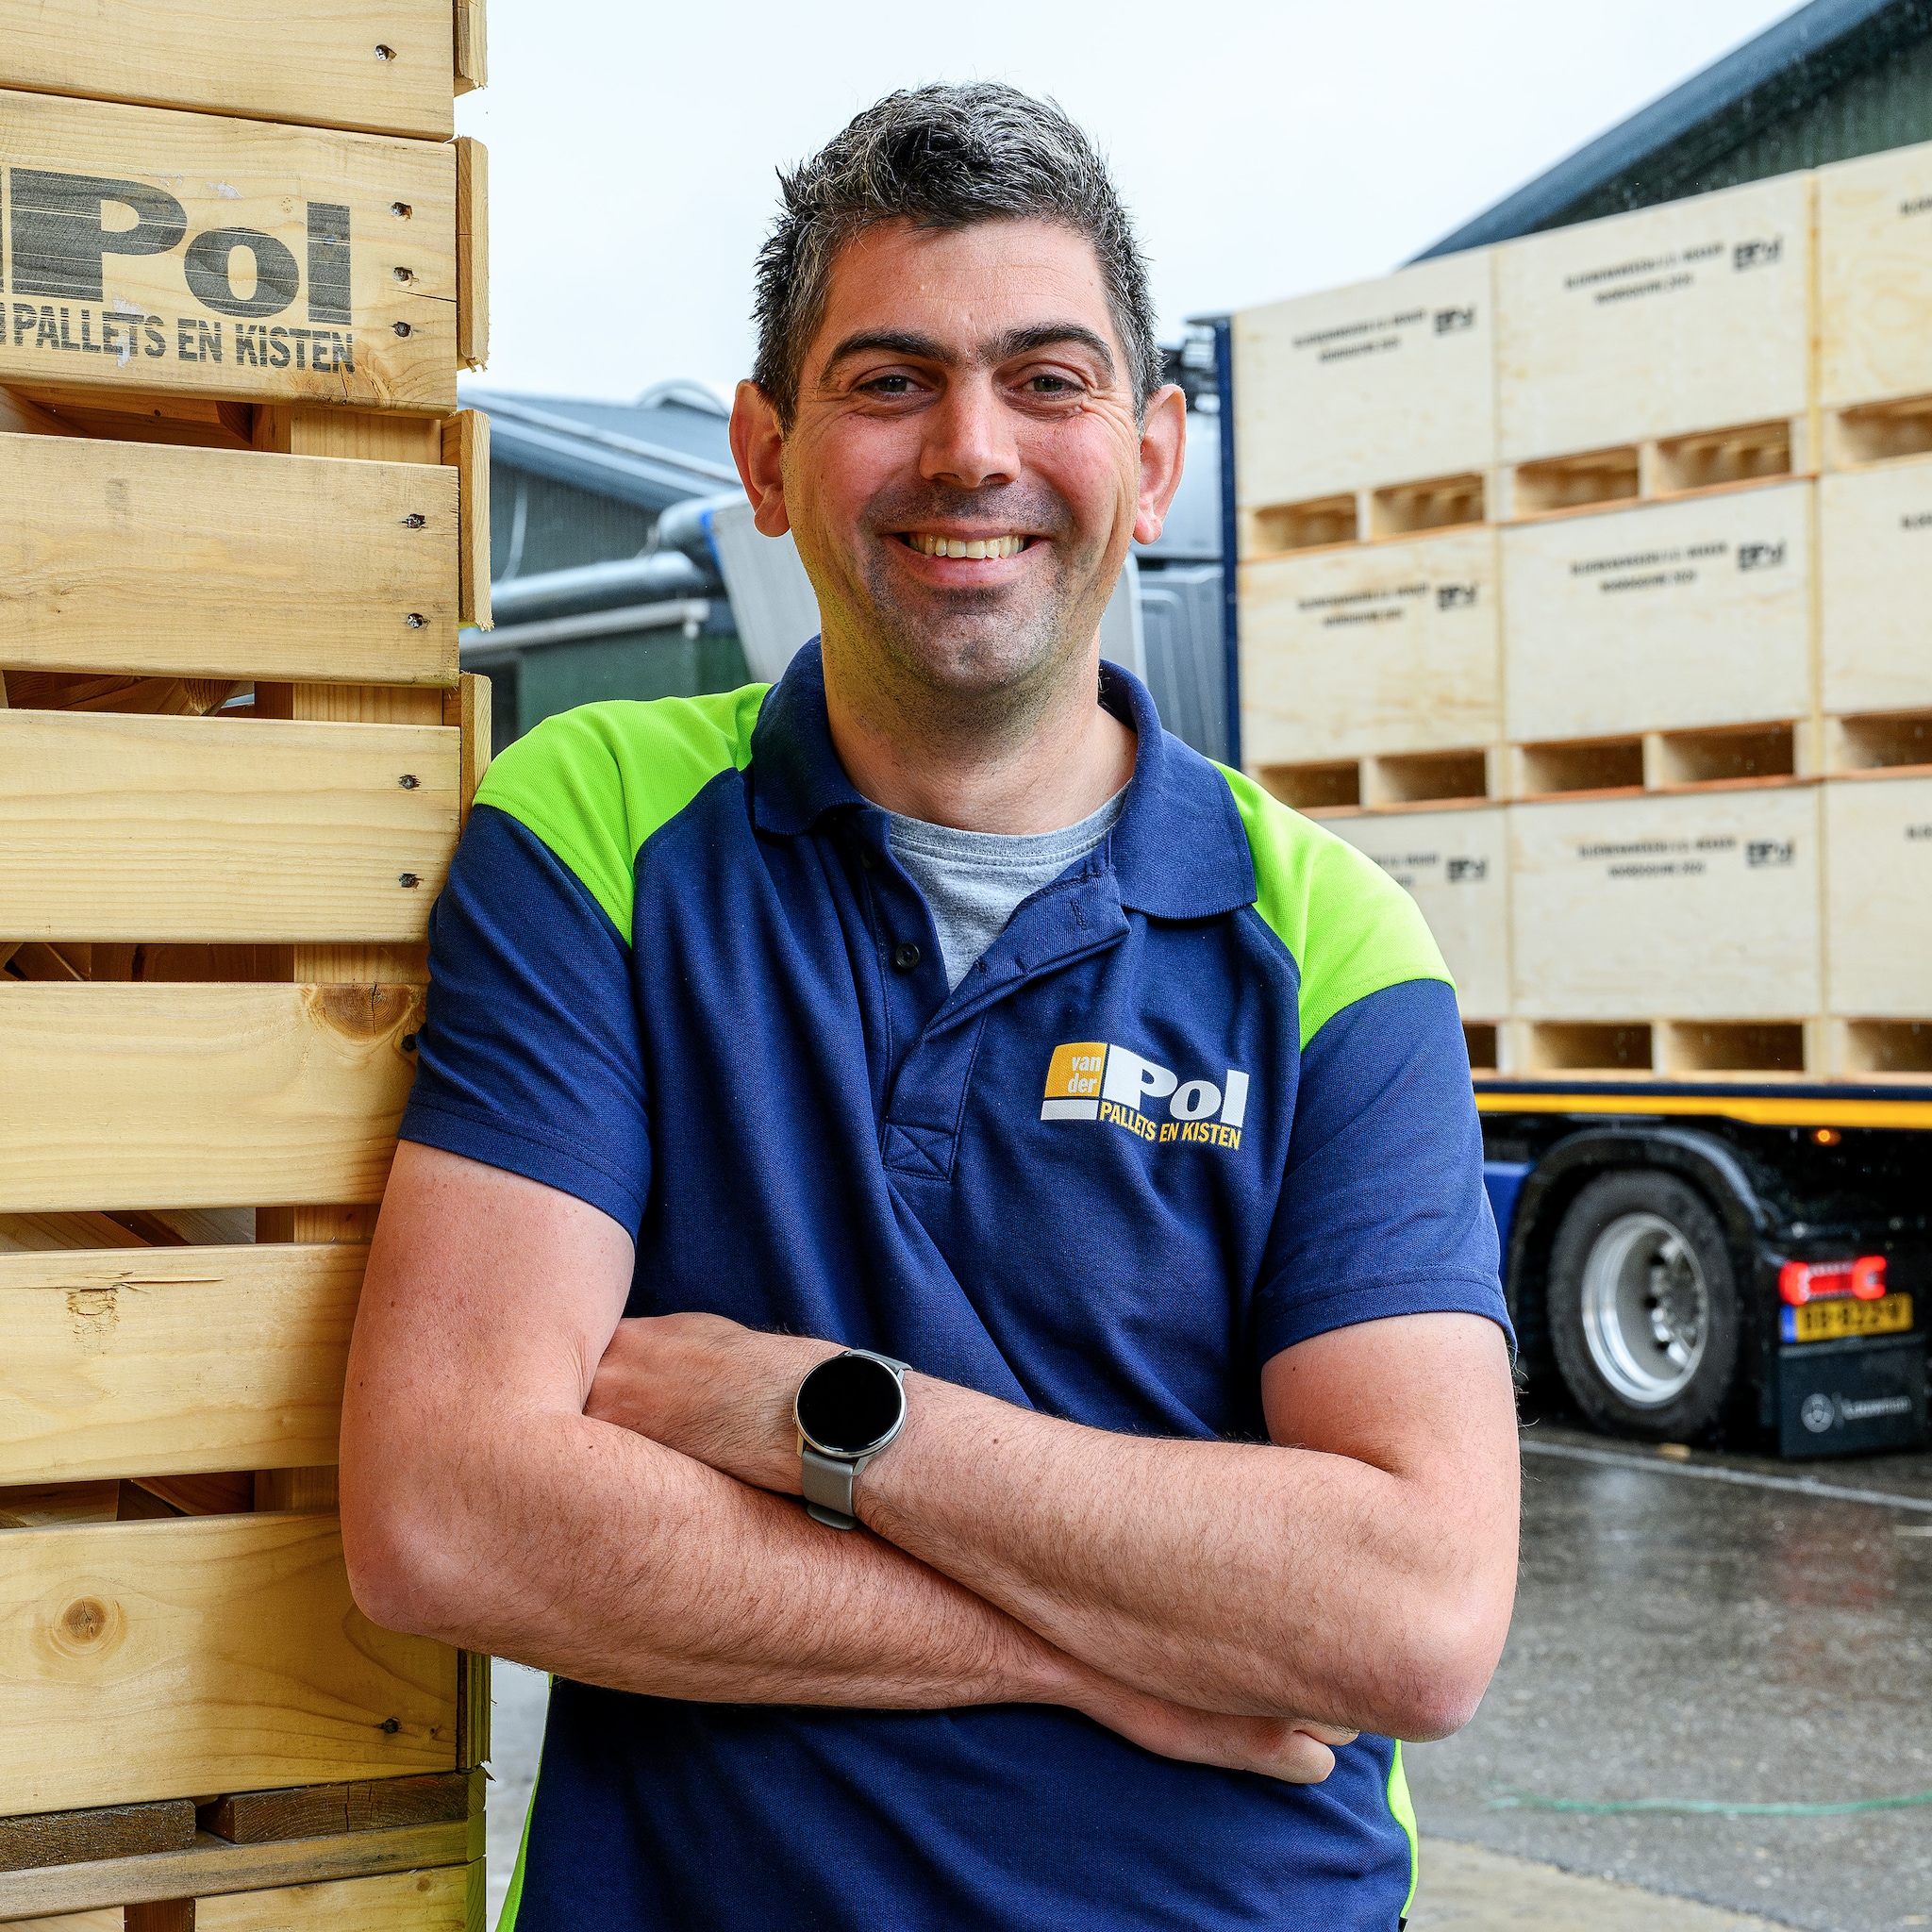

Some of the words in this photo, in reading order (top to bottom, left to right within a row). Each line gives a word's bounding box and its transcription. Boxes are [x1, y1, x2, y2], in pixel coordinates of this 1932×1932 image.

[10, 167, 352, 325] Pol
[13, 303, 166, 358] PALLETS
[177, 318, 222, 363] EN
[236, 323, 355, 374] KISTEN
[1067, 1074, 1098, 1093] der
[1072, 1056, 1101, 1072] van
[1102, 1043, 1249, 1127] Pol
[1099, 1101, 1157, 1141] PALLETS
[1158, 1123, 1179, 1142] EN
[1181, 1122, 1241, 1150] KISTEN
